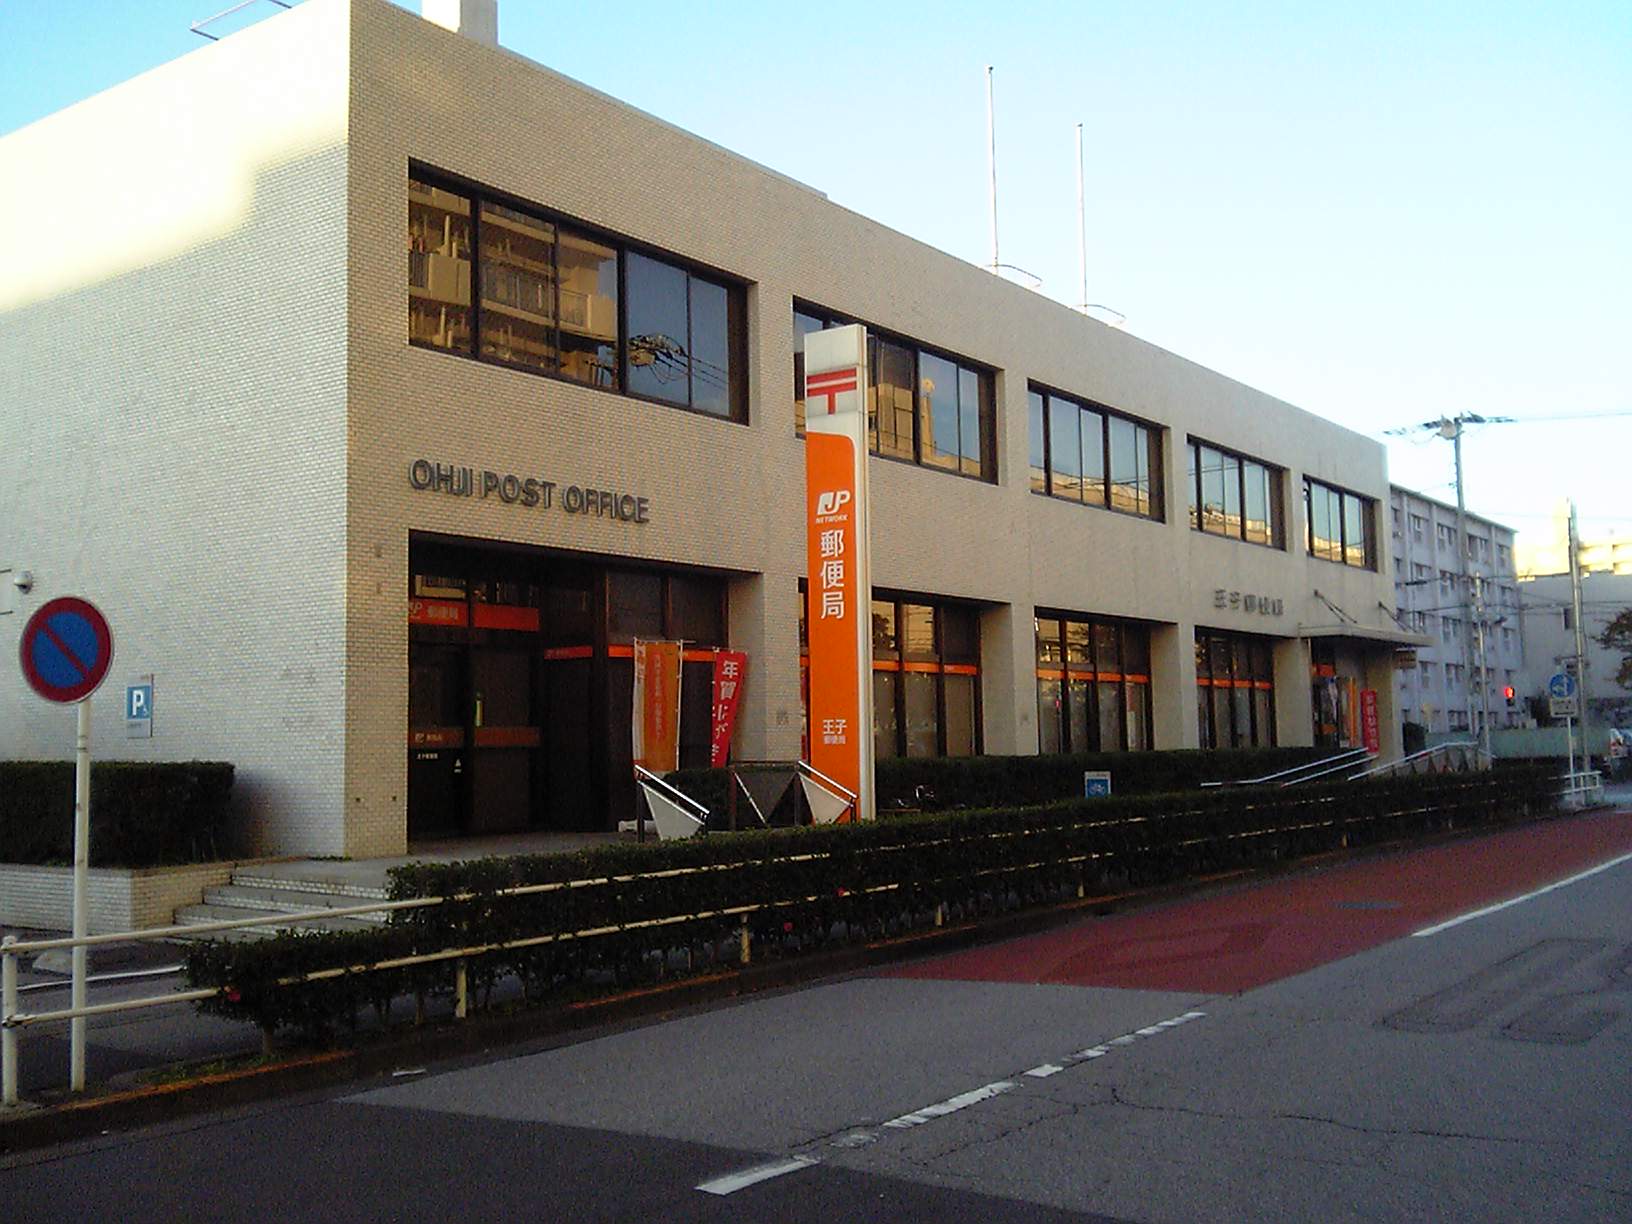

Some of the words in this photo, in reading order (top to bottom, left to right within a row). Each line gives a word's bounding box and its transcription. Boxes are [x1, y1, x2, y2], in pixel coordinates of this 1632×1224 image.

[409, 459, 473, 498] OHJI
[481, 470, 556, 509] POST
[563, 485, 651, 524] OFFICE
[816, 490, 851, 515] JP
[815, 515, 849, 524] NETWORK
[820, 529, 845, 620] 郵便局
[132, 690, 144, 716] P
[823, 719, 848, 735] 王子
